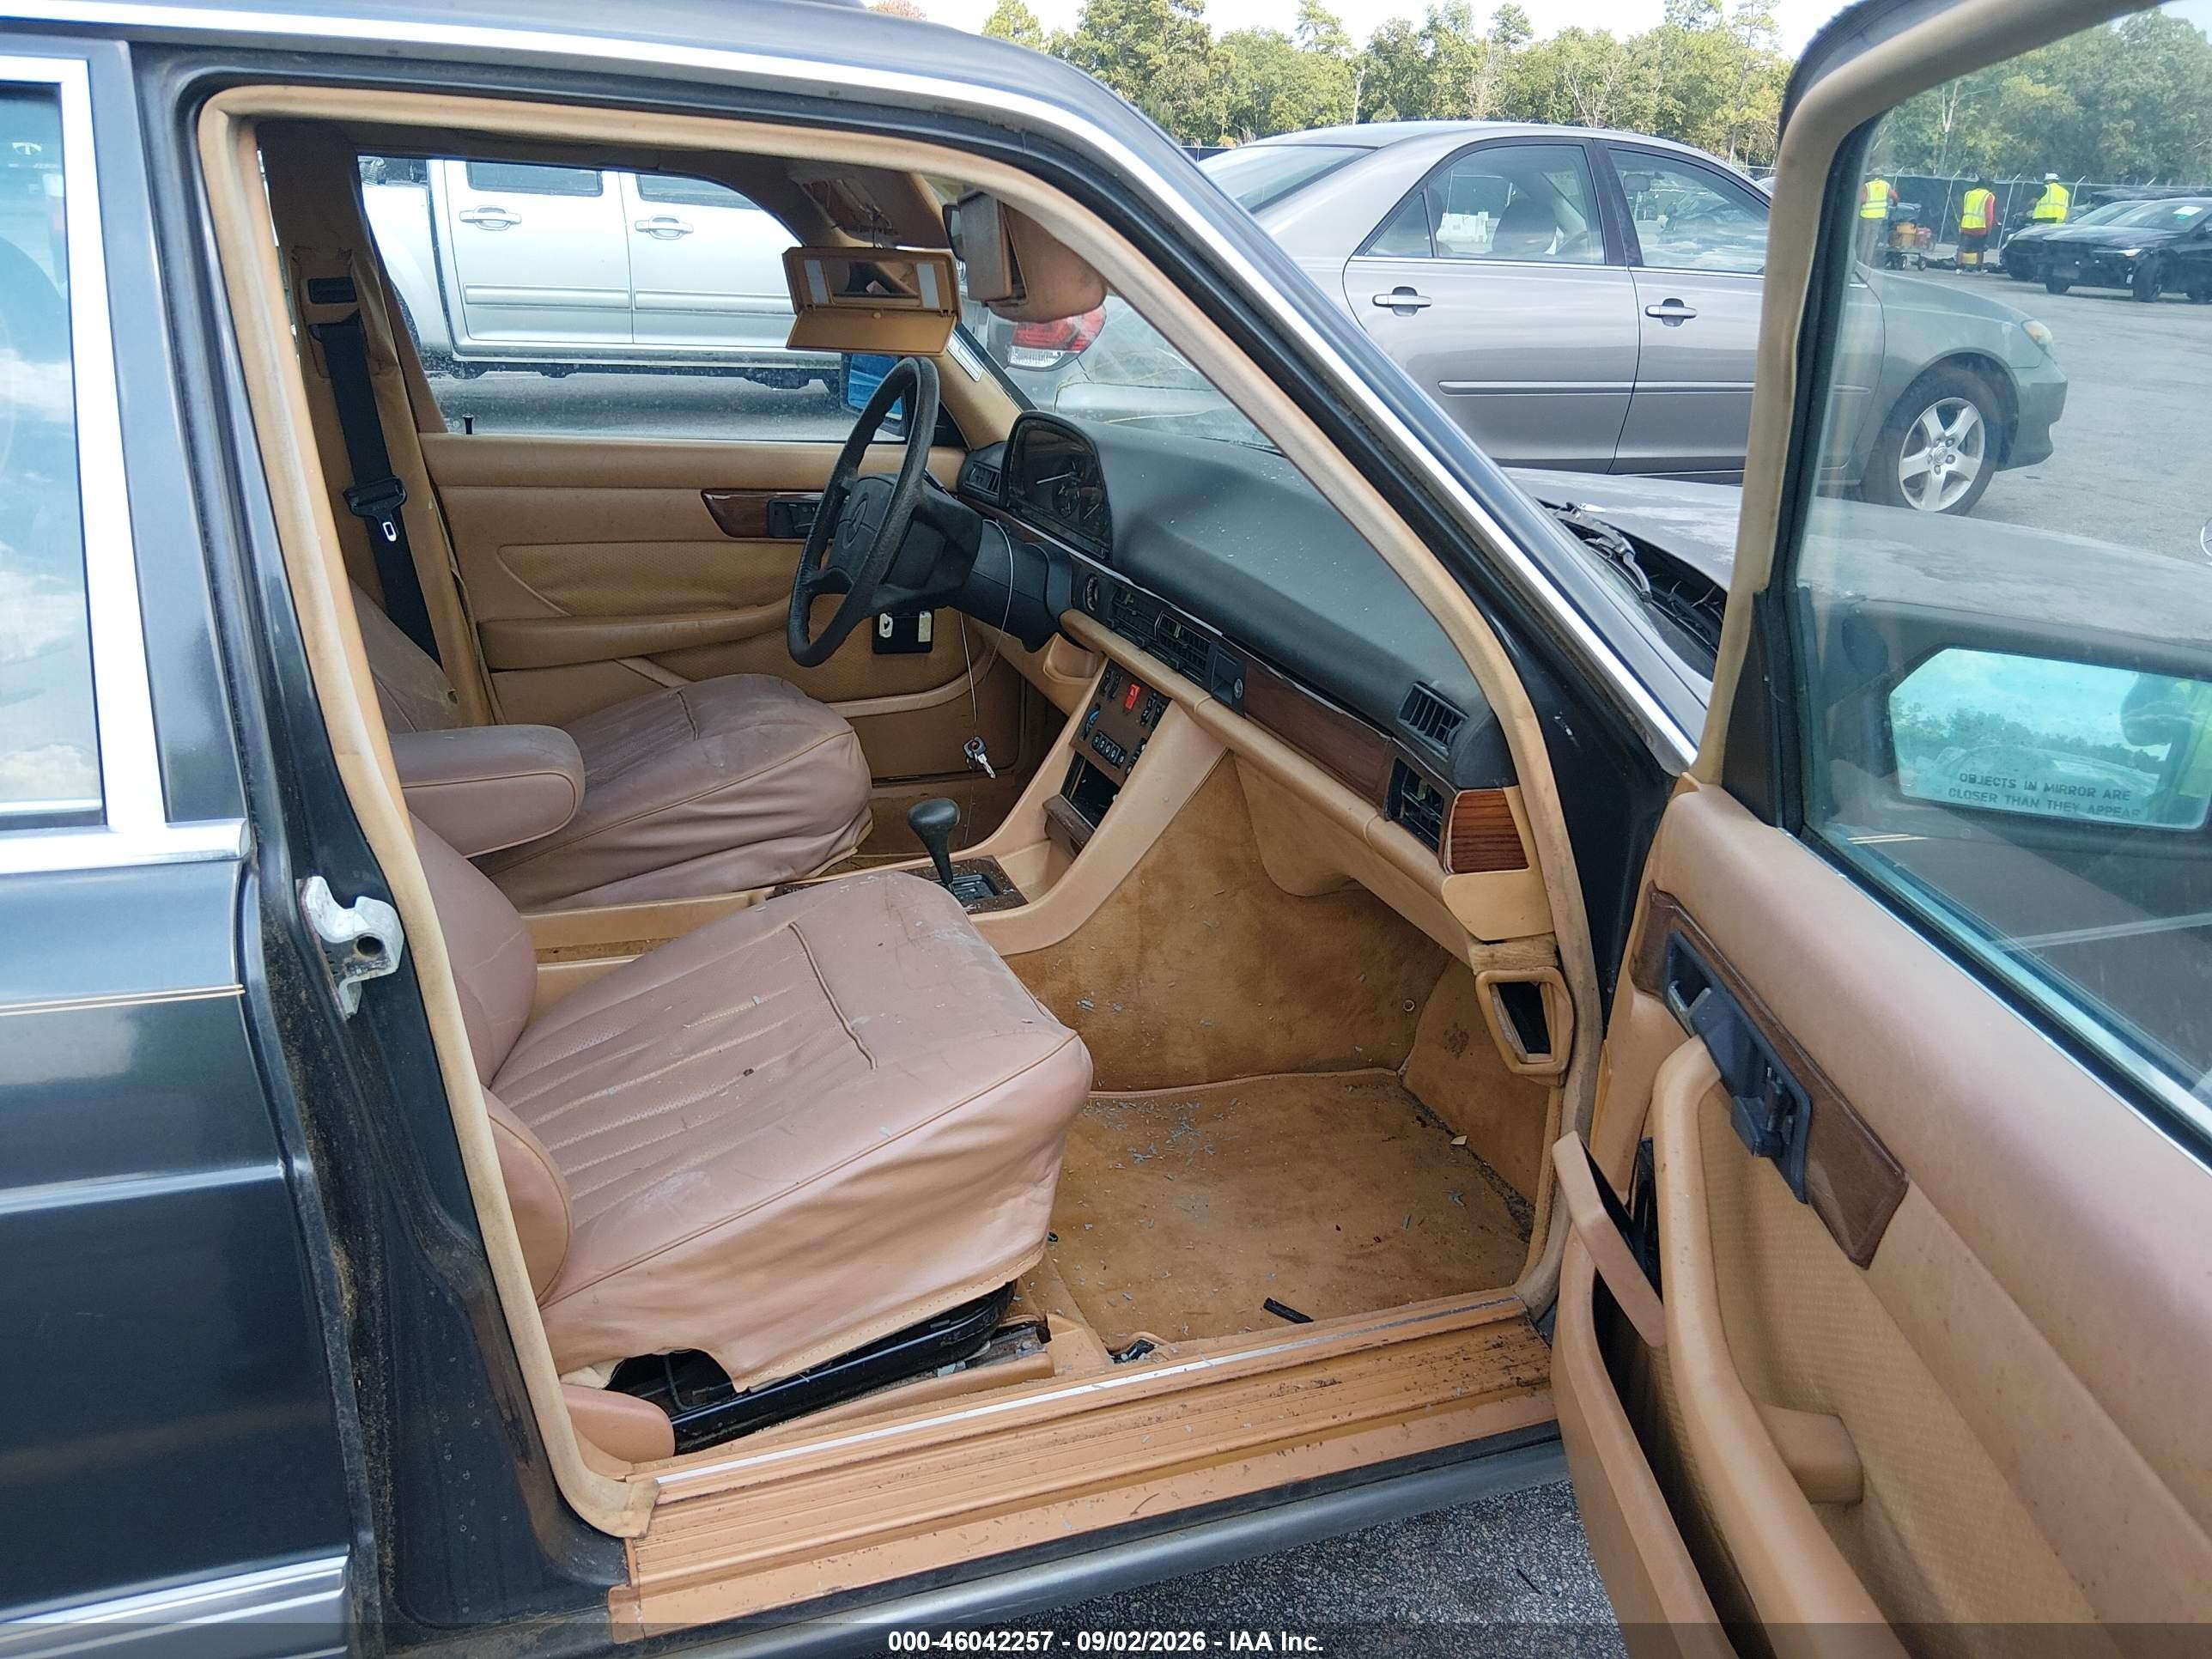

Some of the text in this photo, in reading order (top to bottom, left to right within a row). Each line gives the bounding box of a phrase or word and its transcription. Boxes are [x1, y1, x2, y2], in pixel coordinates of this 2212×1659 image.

[1948, 787, 1998, 803] CLOSER
[2005, 794, 2040, 808] THAN
[2047, 799, 2081, 812] THEY
[1959, 773, 2130, 801] OBJECTS IN MIRROR ARE
